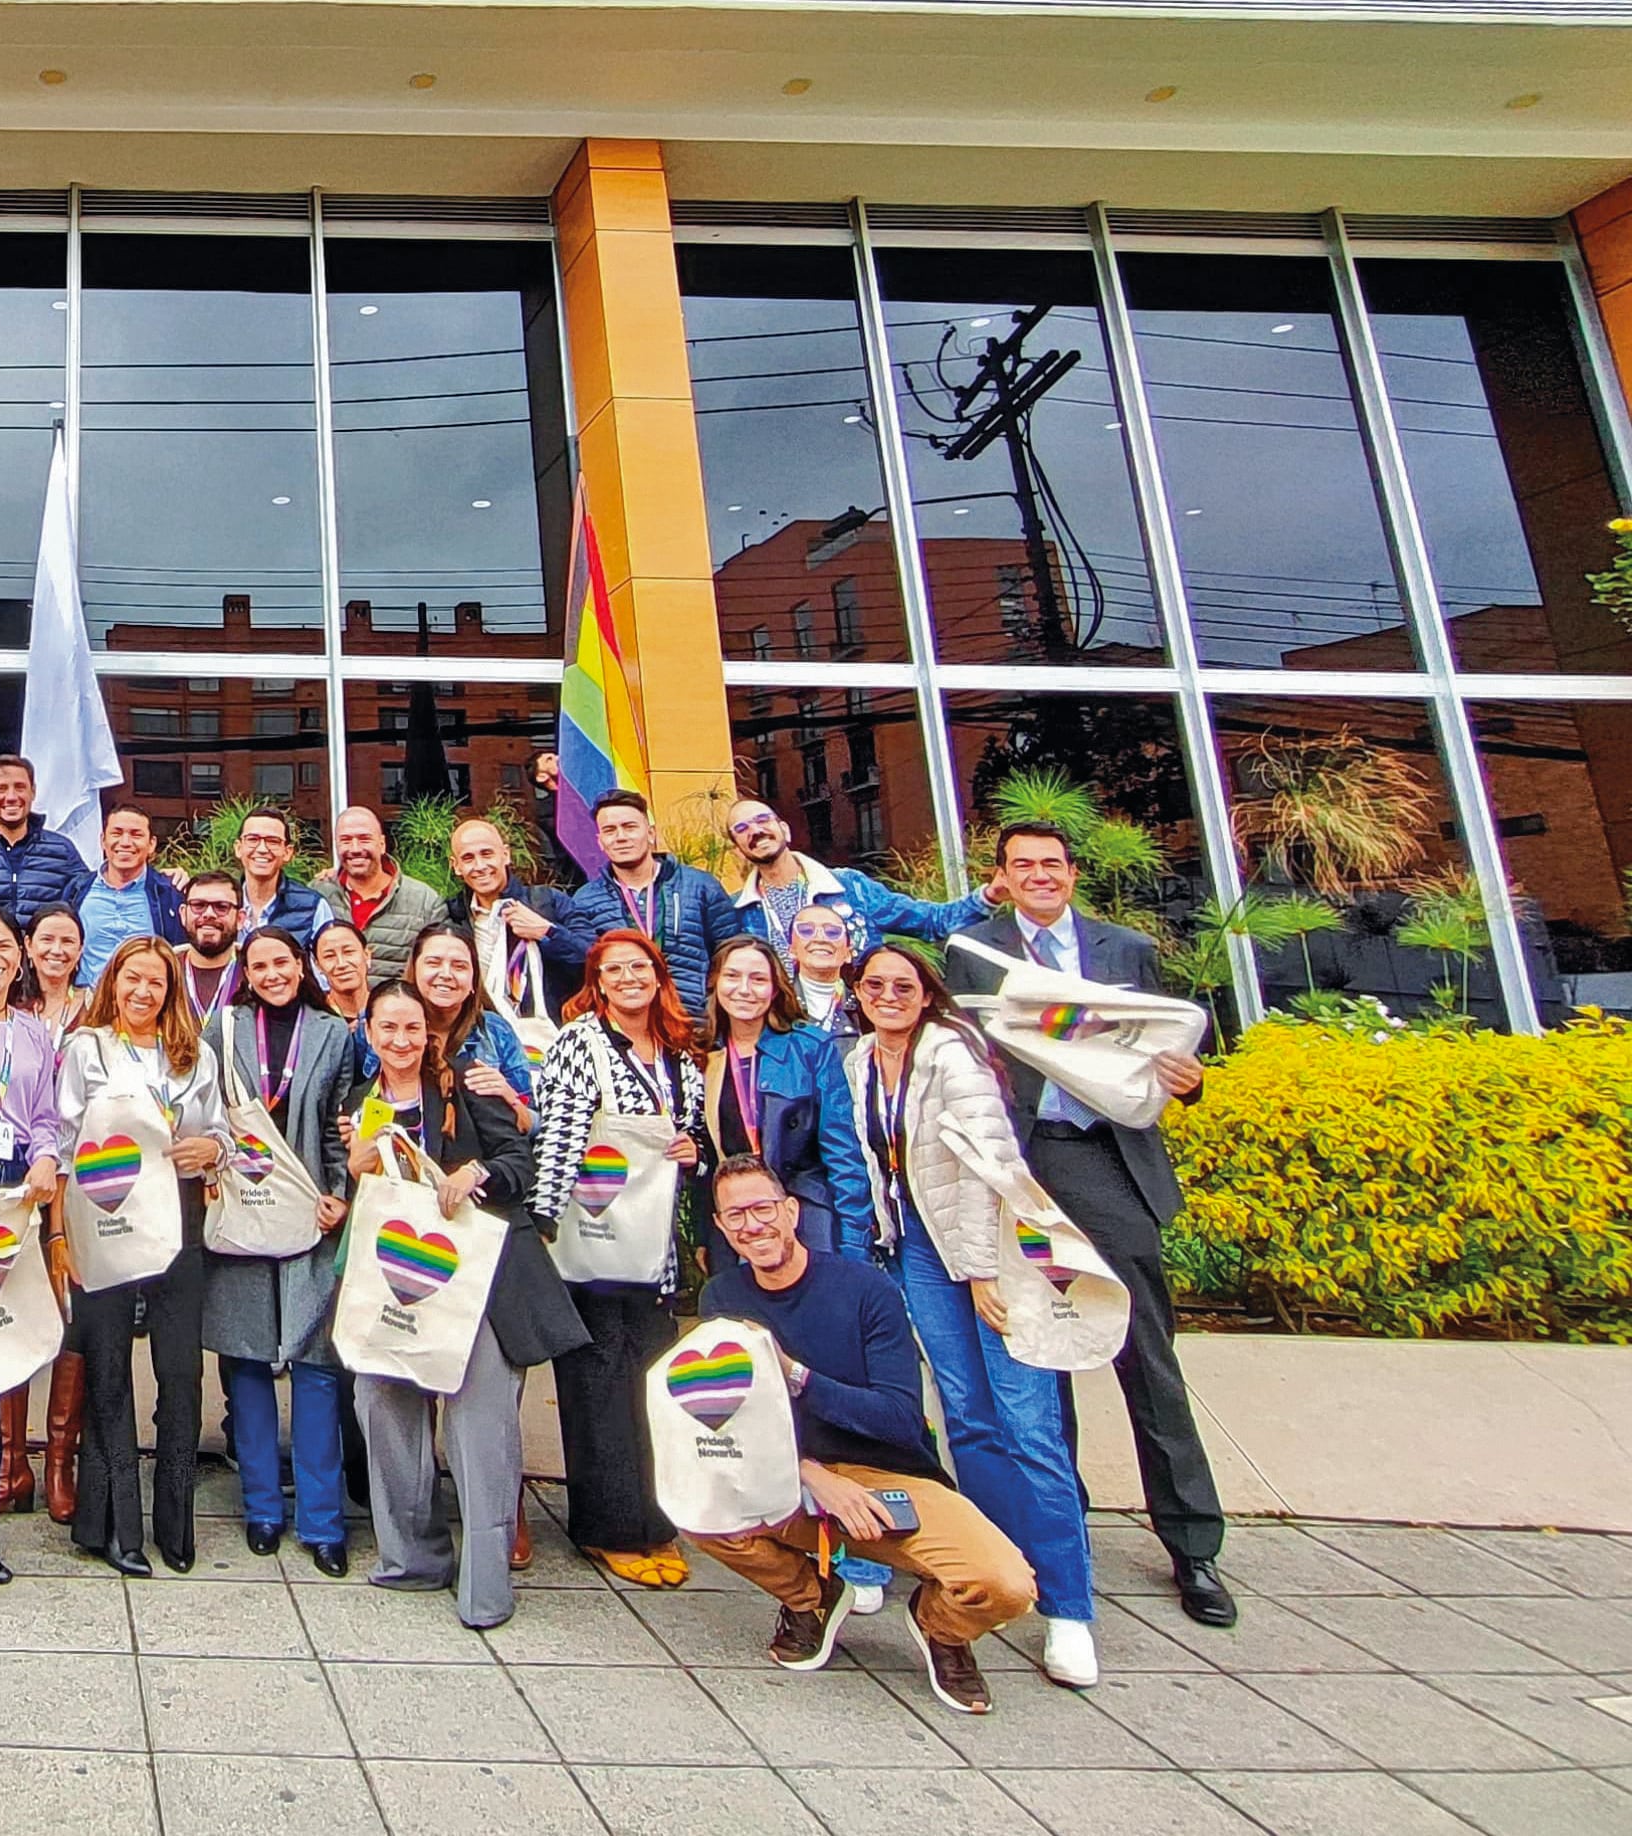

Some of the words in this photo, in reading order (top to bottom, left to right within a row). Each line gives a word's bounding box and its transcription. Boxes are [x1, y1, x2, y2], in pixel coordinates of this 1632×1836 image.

[239, 1189, 271, 1198] Pride@
[241, 1198, 276, 1206] Novartis
[696, 1436, 734, 1448] Pride@
[698, 1447, 743, 1458] Novartis
